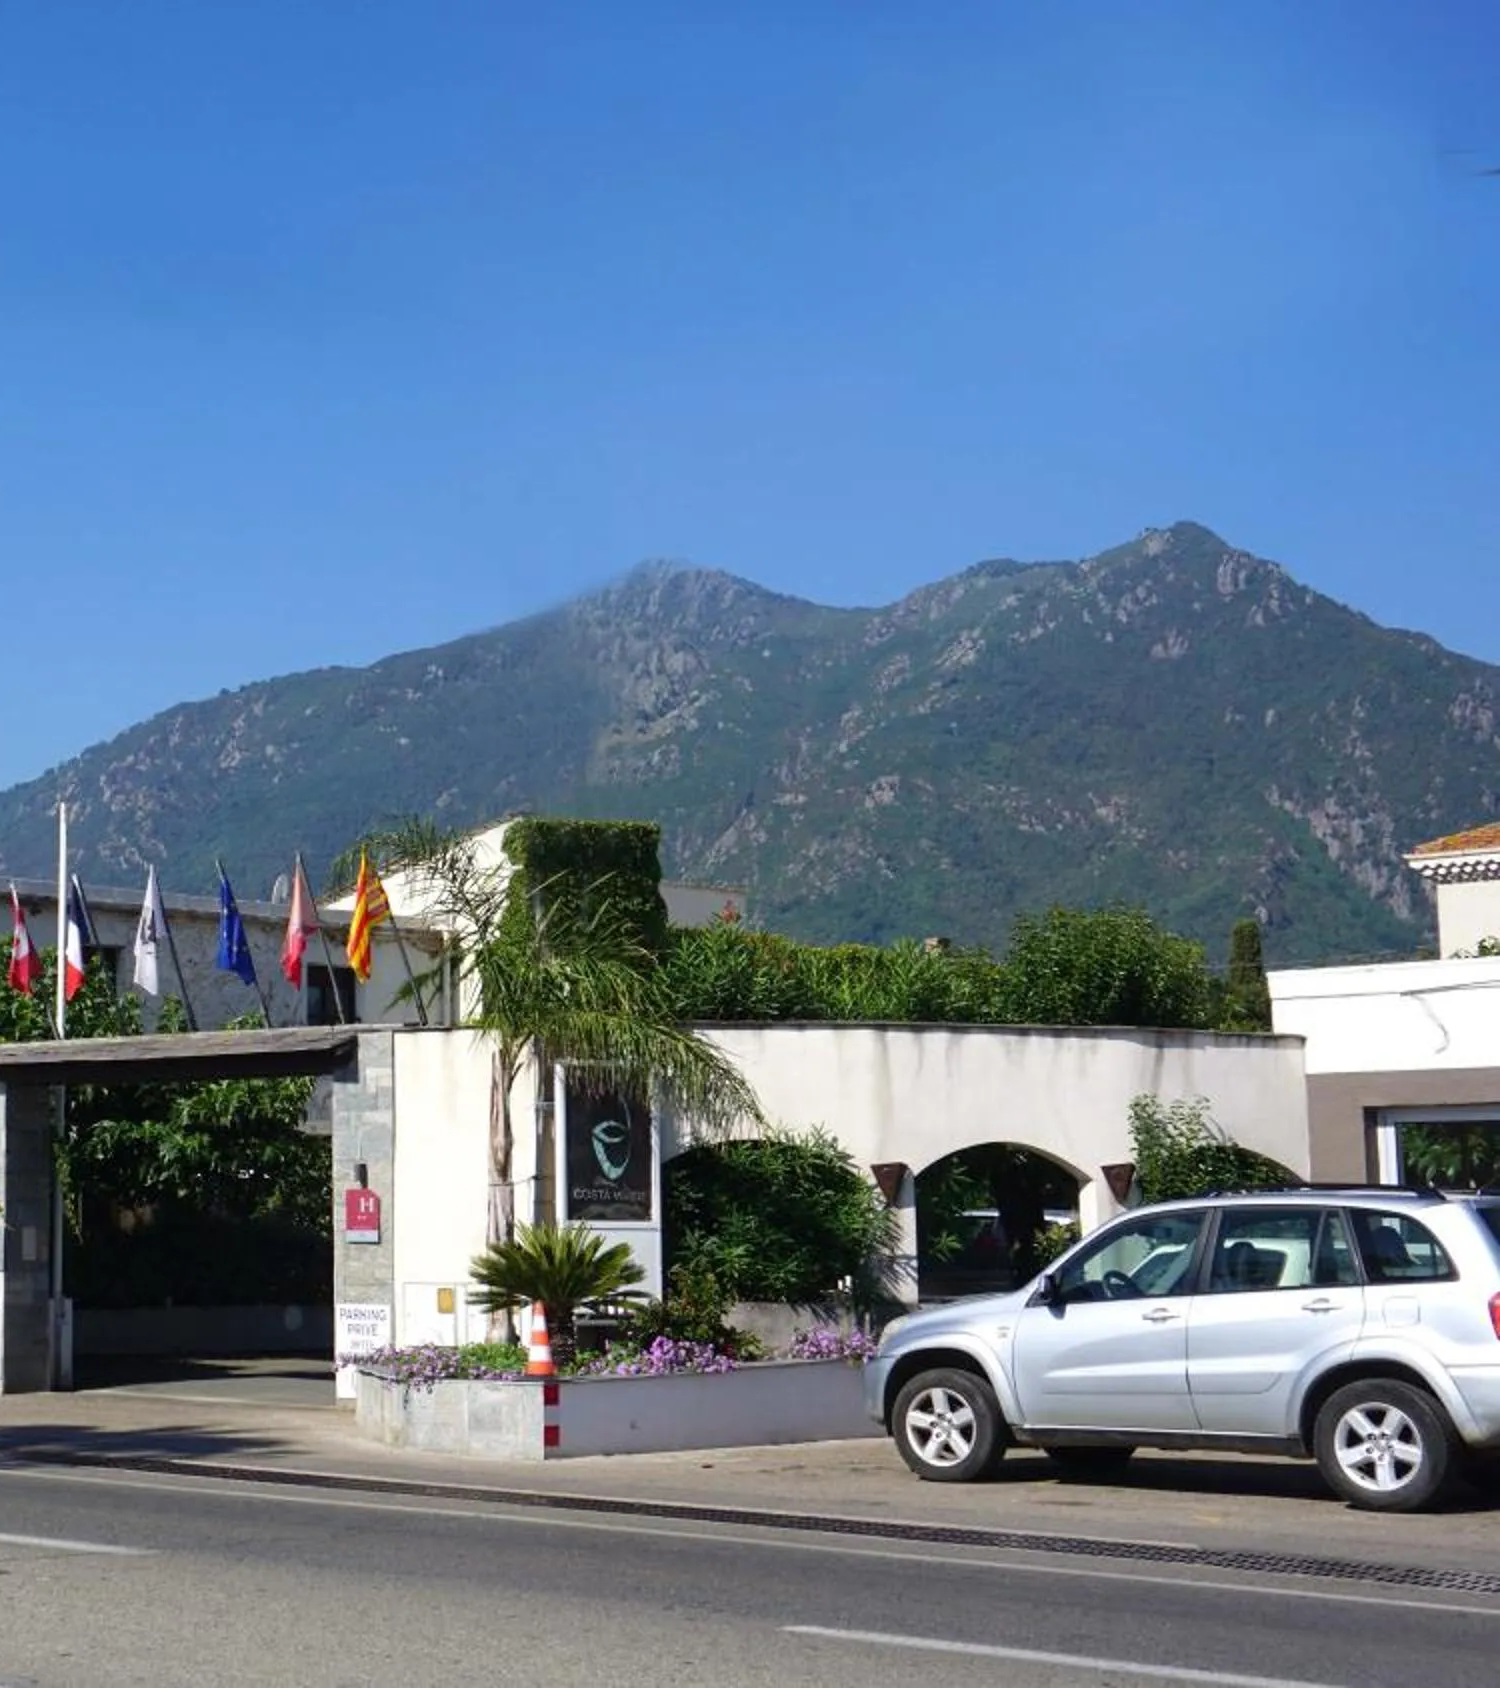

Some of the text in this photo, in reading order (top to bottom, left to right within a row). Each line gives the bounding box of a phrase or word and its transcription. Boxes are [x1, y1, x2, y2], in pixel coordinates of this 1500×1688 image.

[573, 1187, 611, 1201] COSTA
[360, 1197, 374, 1212] H
[339, 1307, 387, 1321] PARKING
